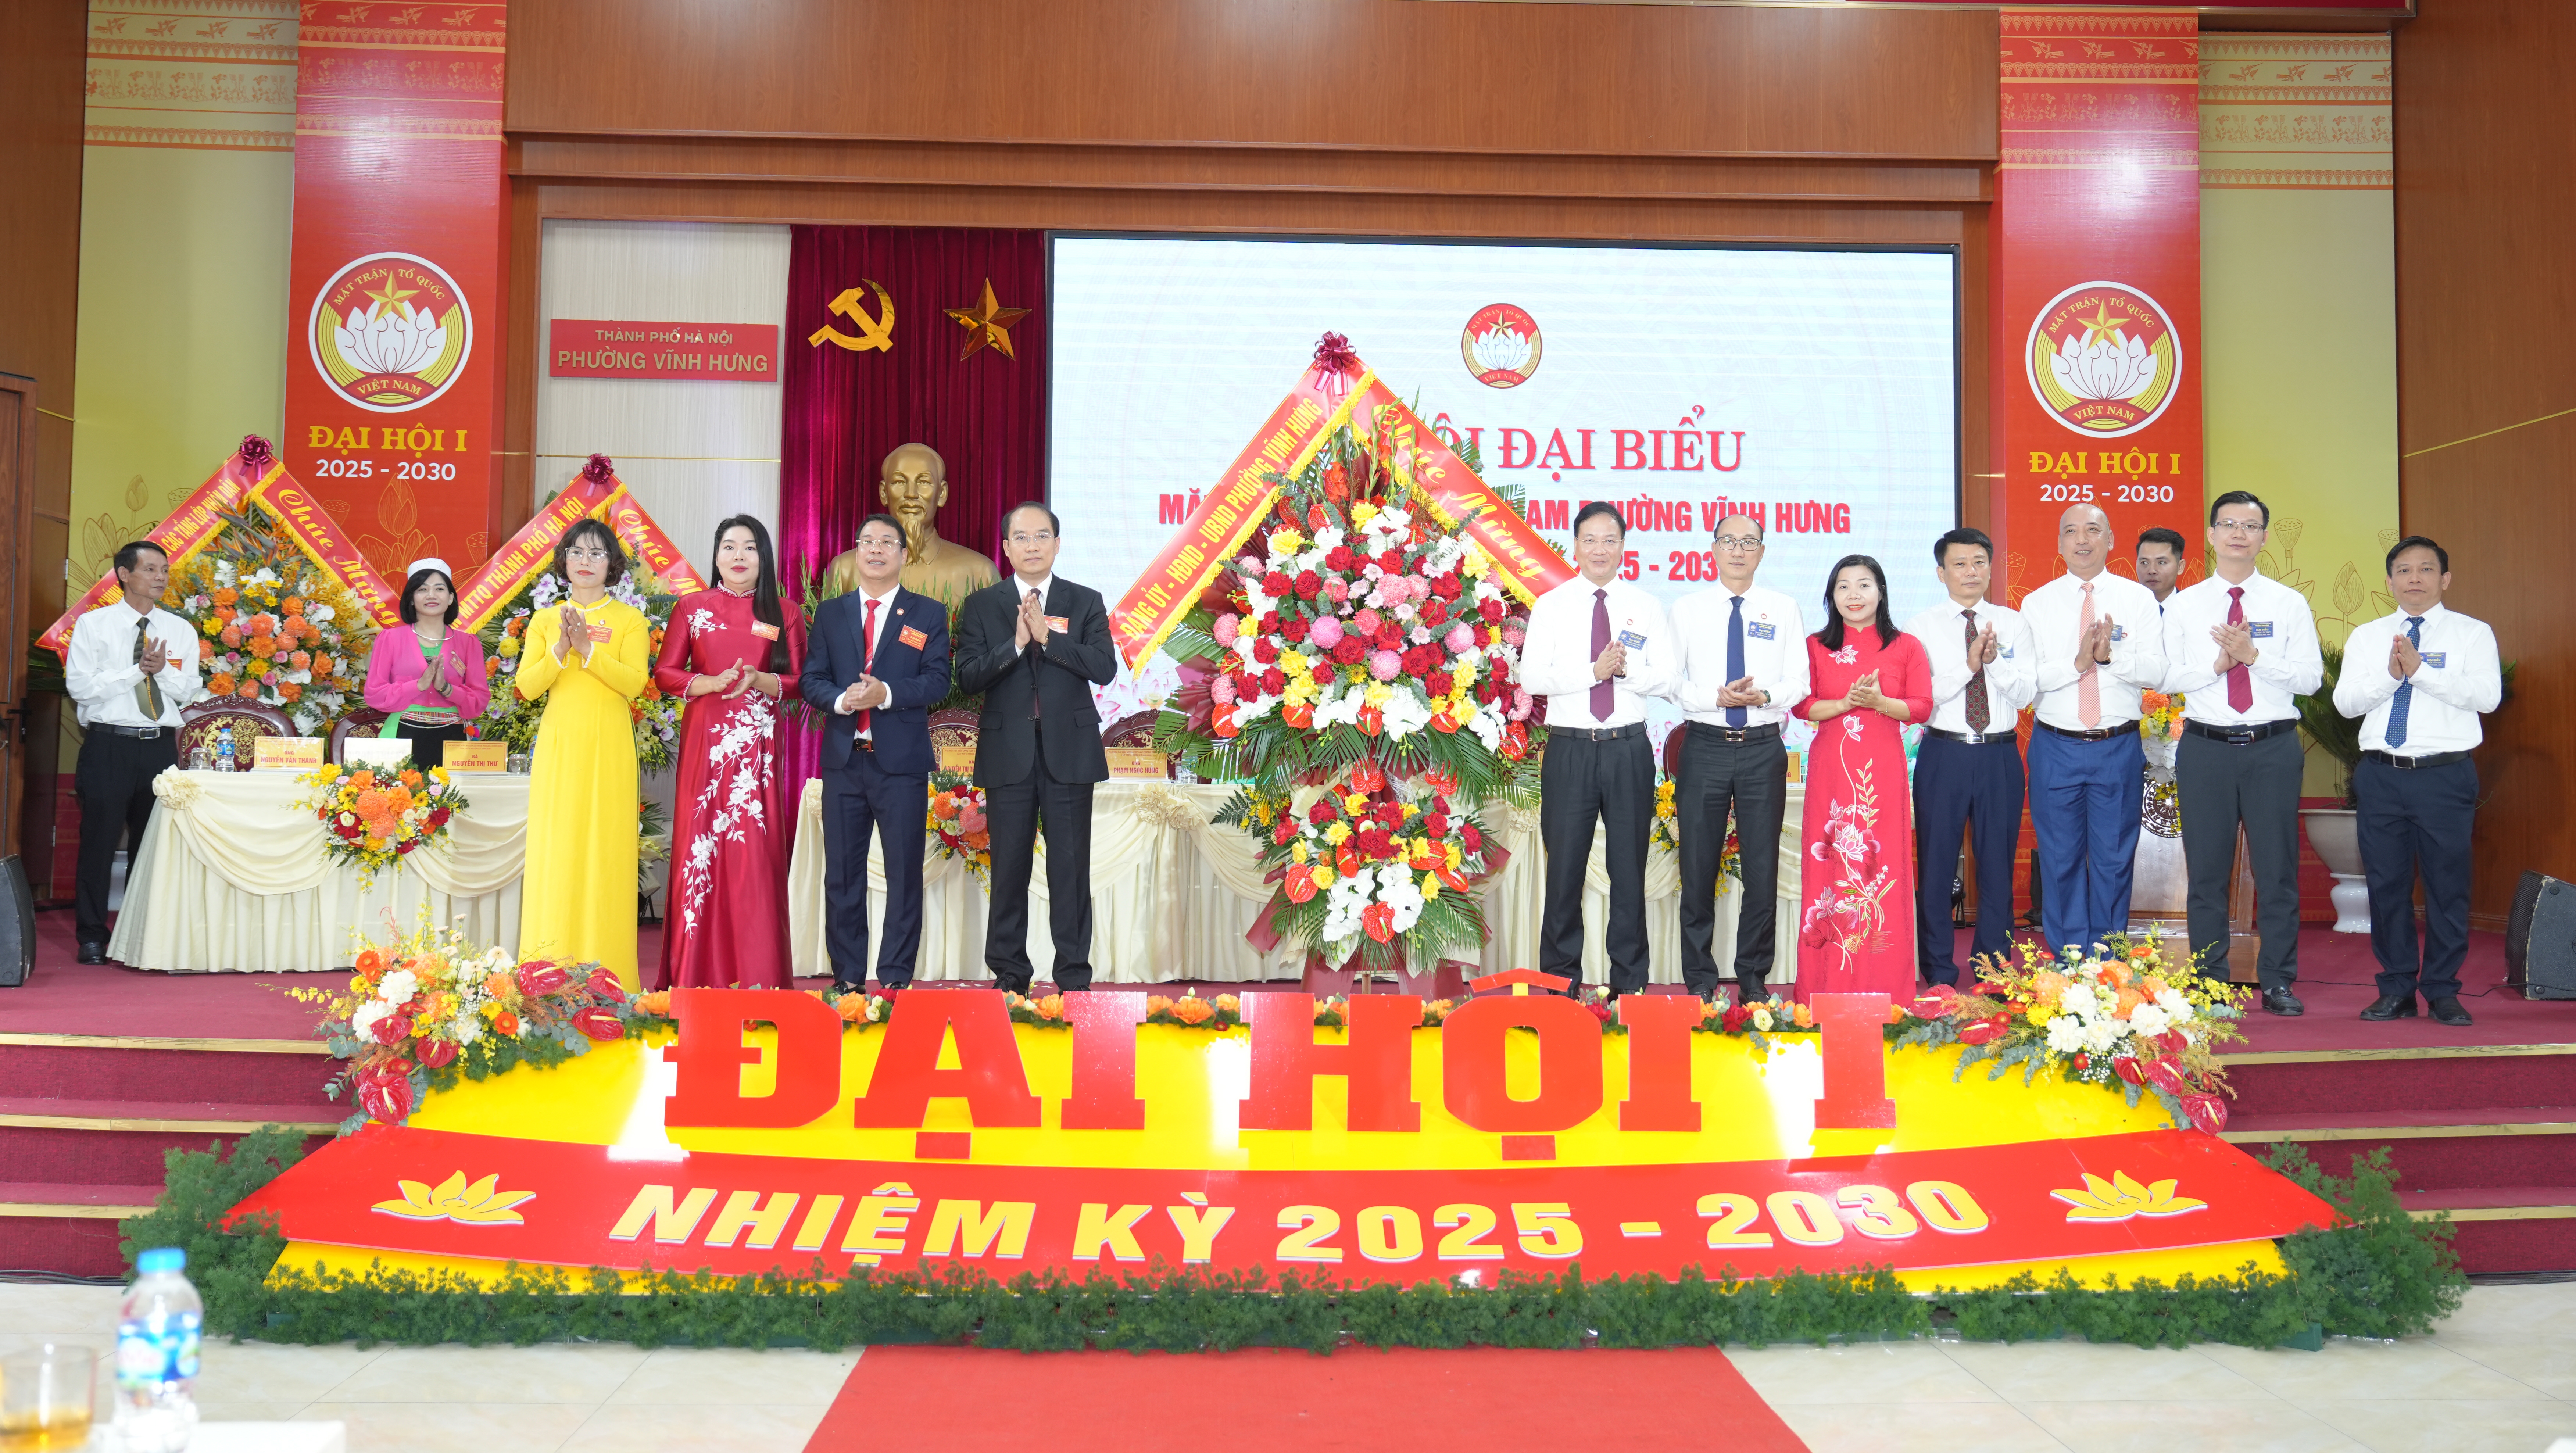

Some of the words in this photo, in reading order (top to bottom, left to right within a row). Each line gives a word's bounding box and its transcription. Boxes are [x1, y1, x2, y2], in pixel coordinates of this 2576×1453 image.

[333, 282, 355, 306] MẶT
[355, 268, 387, 285] TRẬN
[398, 268, 415, 279] TỔ
[416, 275, 445, 300] QUỐC
[2049, 310, 2068, 333] MẶT
[2068, 297, 2099, 313] TRẬN
[2109, 297, 2126, 307] TỔ
[2127, 304, 2154, 328] QUỐC
[595, 327, 645, 342] THÀNH
[650, 327, 681, 343] PHỐ
[684, 329, 704, 344] HÀ
[708, 330, 733, 347] NỘI
[558, 346, 646, 369] PHƯỜNG
[654, 349, 701, 371] VĨNH
[709, 352, 768, 372] HƯNG
[1503, 373, 1519, 382] NAM
[357, 379, 389, 394] VIỆT
[392, 380, 422, 396] NAM
[2073, 405, 2103, 420] VIỆT
[2107, 405, 2135, 421] NAM
[308, 426, 371, 455] ĐẠI
[381, 422, 444, 458] HỘI
[455, 430, 468, 451] I
[1498, 427, 1595, 482] ĐẠI
[1610, 405, 1745, 472] BIỂU
[316, 459, 372, 478] 2025
[397, 462, 456, 481] 2030
[2029, 452, 2087, 479] ĐẠI
[2099, 446, 2158, 481] HỘI
[2169, 453, 2180, 474] I
[1370, 404, 1446, 484] Chúc
[1447, 489, 1546, 581] Mừng
[2040, 484, 2094, 502] 2025
[2118, 485, 2174, 503] 2030
[161, 532, 184, 552] CÁC
[173, 519, 200, 540] TẦNG
[190, 505, 210, 526] LỚP
[202, 491, 228, 514] NHÂN
[218, 478, 241, 499] DÂN
[1119, 601, 1159, 641] ĐẢNG
[1141, 583, 1171, 608] ỦY
[1166, 544, 1205, 584] HĐND
[1199, 504, 1237, 543] UBND
[1225, 457, 1276, 512] PHƯỜNG
[1262, 427, 1298, 464] VĨNH
[1285, 398, 1323, 438] HƯNG
[1579, 493, 1692, 532] ƯỜNG
[1775, 500, 1850, 533] HƯNG
[459, 584, 493, 619] MTTQ
[484, 550, 528, 590] THÀNH
[520, 523, 550, 558] PHỐ
[543, 513, 567, 536] HÀ
[559, 496, 586, 521] NỘI
[618, 509, 669, 569] Chúc
[278, 489, 334, 551] Chúc
[333, 556, 400, 627] Mừng
[1668, 551, 1718, 581] 203
[663, 987, 1146, 1159] ĐẠI
[1238, 967, 1702, 1161] HỘI
[1811, 992, 1897, 1129] I
[608, 1181, 1037, 1267] NHIỆM
[1072, 1191, 1236, 1264] KỲ
[1276, 1202, 1584, 1264] 2025
[1696, 1180, 1989, 1250] 2030
